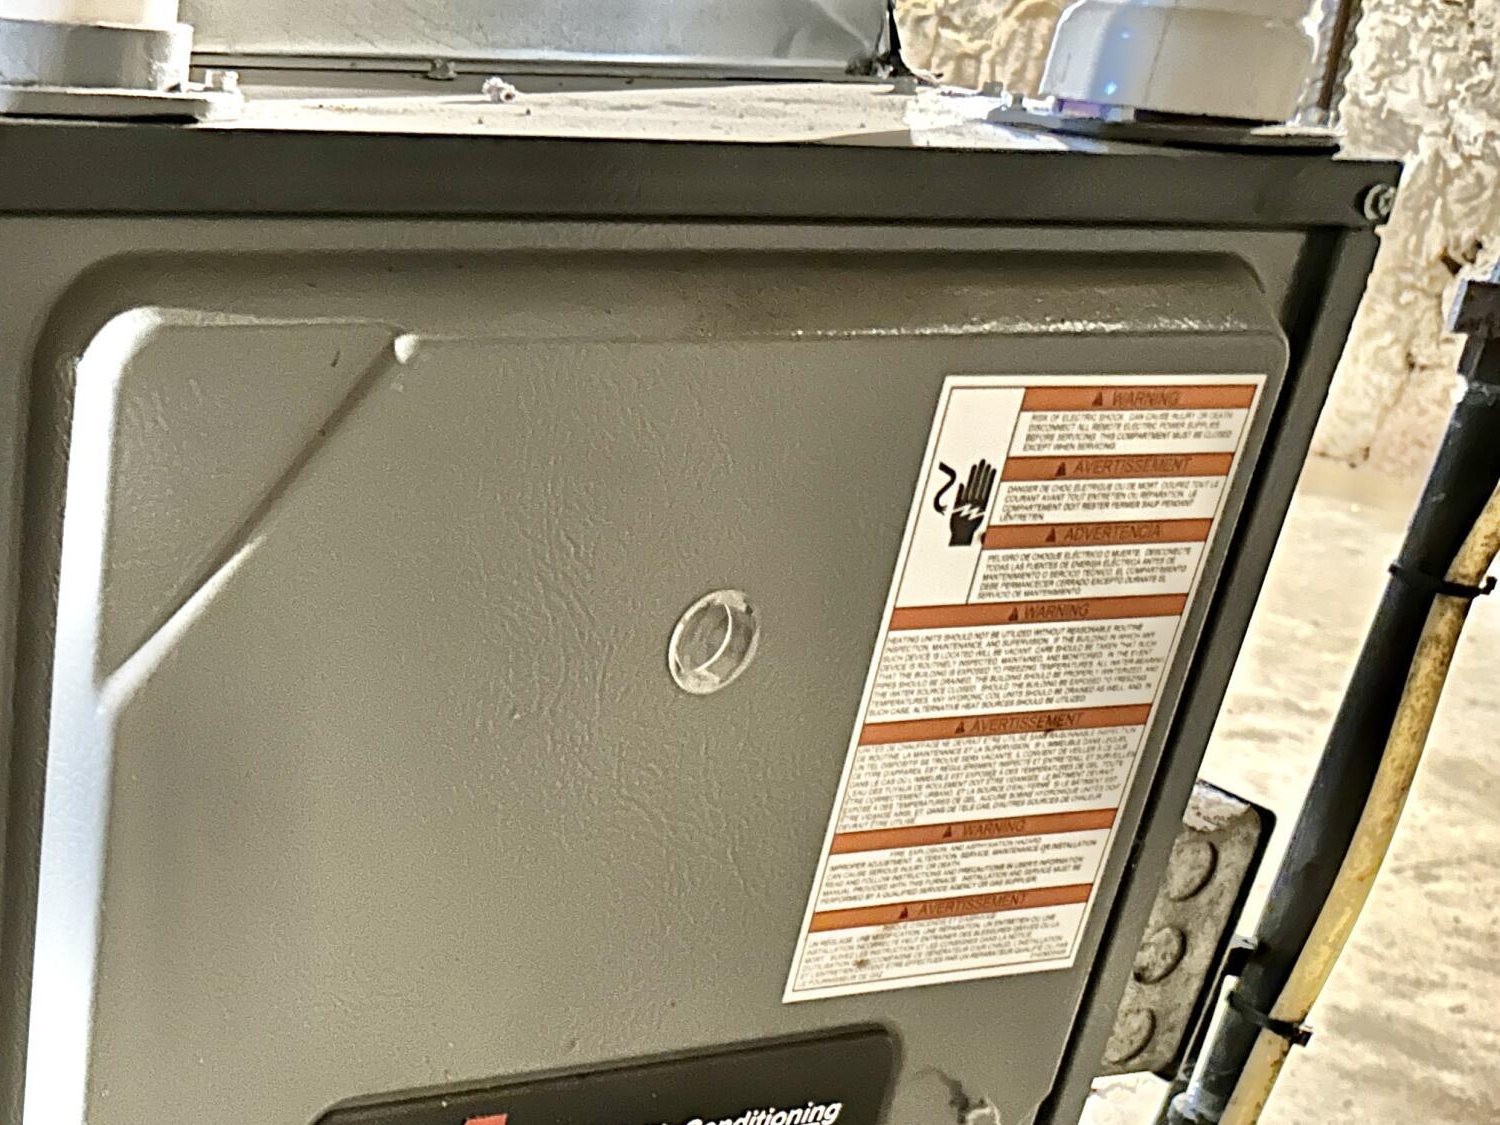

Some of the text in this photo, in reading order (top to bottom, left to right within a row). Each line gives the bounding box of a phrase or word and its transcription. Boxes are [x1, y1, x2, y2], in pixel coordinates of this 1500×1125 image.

[1110, 390, 1181, 406] WARNING
[1072, 457, 1191, 474] AVERTISSEMENT
[1063, 524, 1163, 542] ADVERTENCIA
[1022, 599, 1092, 619] WARNING
[970, 712, 1083, 732] AVERTISSEMENT
[960, 819, 1026, 837] WARNING
